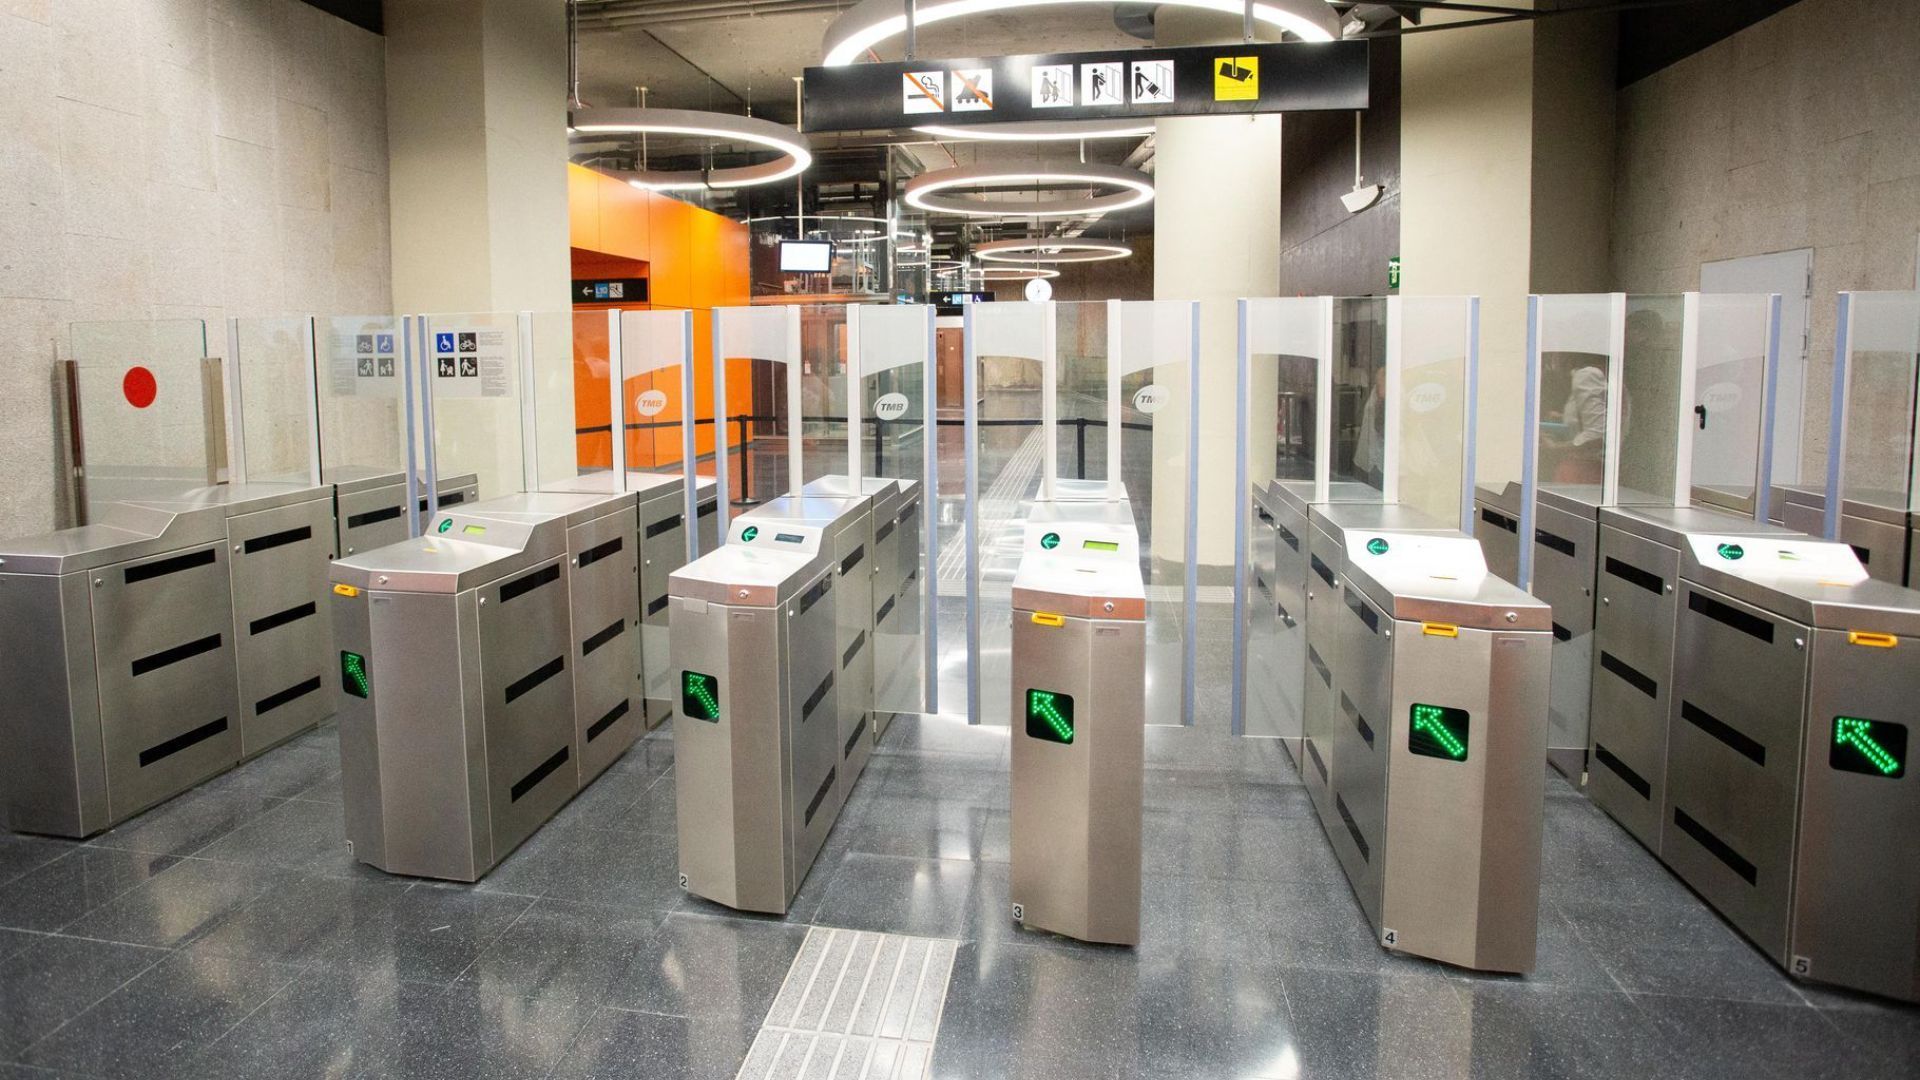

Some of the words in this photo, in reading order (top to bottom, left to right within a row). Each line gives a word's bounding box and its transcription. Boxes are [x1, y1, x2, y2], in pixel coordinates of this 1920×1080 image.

[881, 403, 904, 411] TMB
[680, 875, 687, 888] 2
[1014, 905, 1022, 919] 3
[1385, 932, 1396, 945] 4
[1795, 959, 1808, 974] 5
